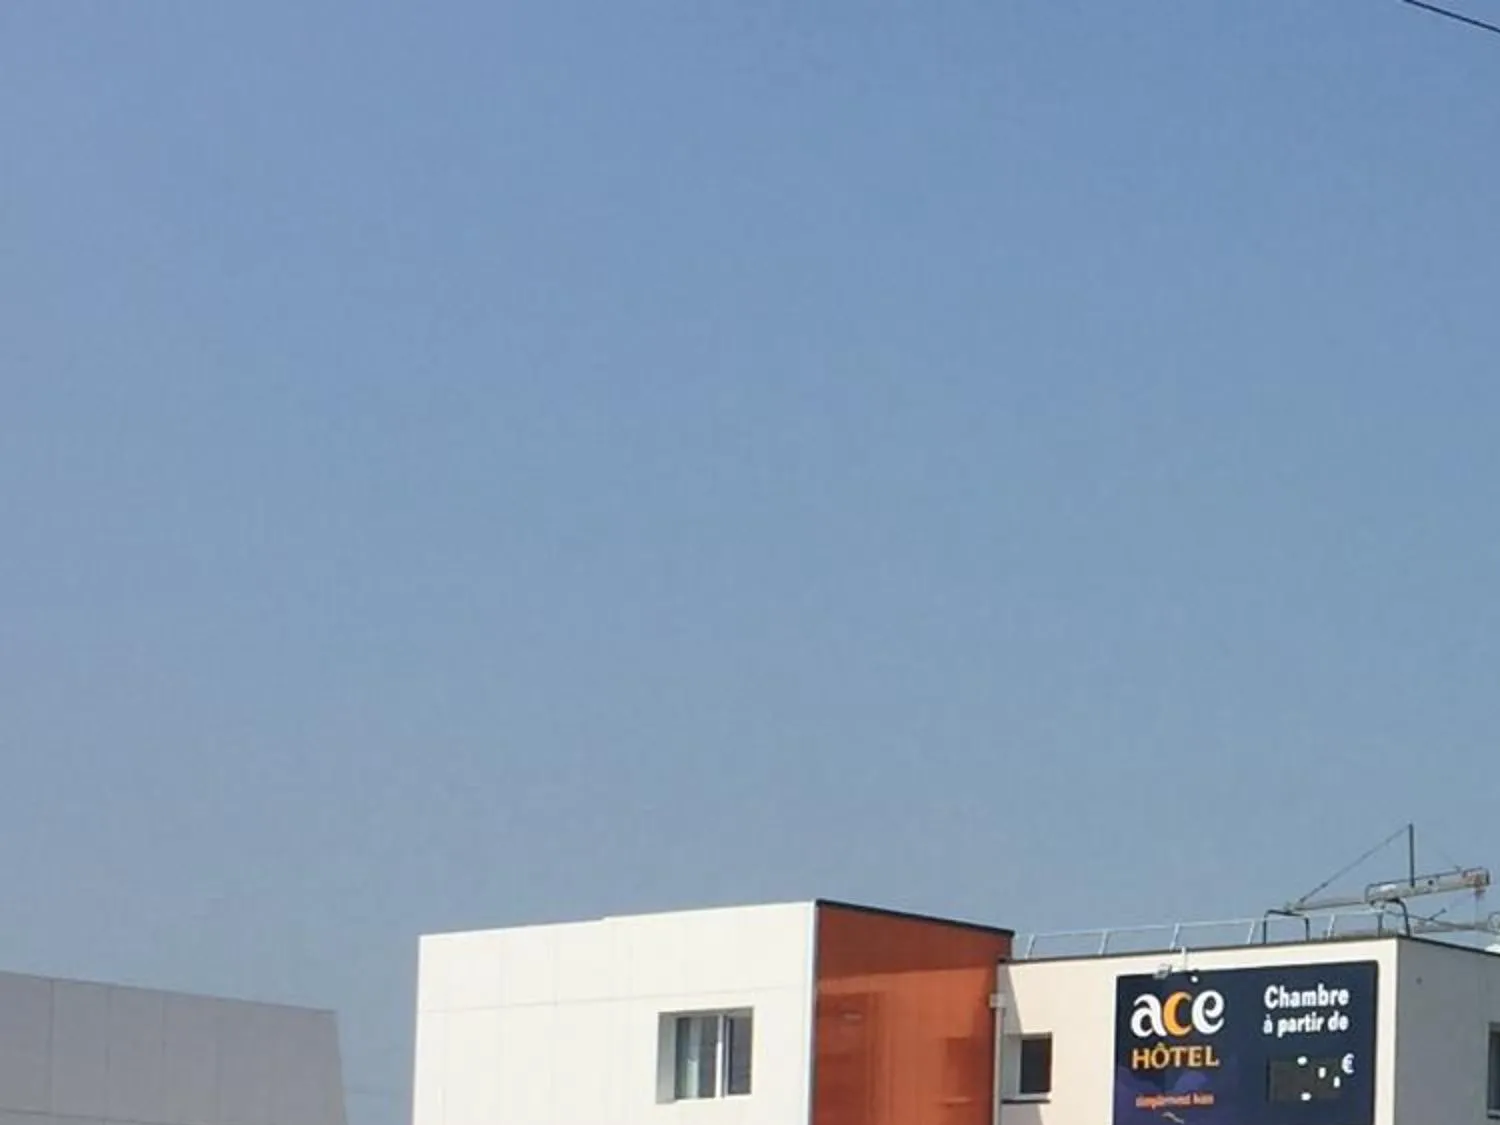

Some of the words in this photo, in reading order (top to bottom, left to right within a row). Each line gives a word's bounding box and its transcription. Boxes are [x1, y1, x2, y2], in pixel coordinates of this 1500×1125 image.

[1264, 984, 1349, 1009] Chambre
[1131, 989, 1224, 1037] ace
[1263, 1013, 1274, 1034] à
[1277, 1012, 1324, 1038] partir
[1328, 1011, 1349, 1031] de
[1132, 1042, 1220, 1069] HÔTEL
[1342, 1053, 1355, 1074] €
